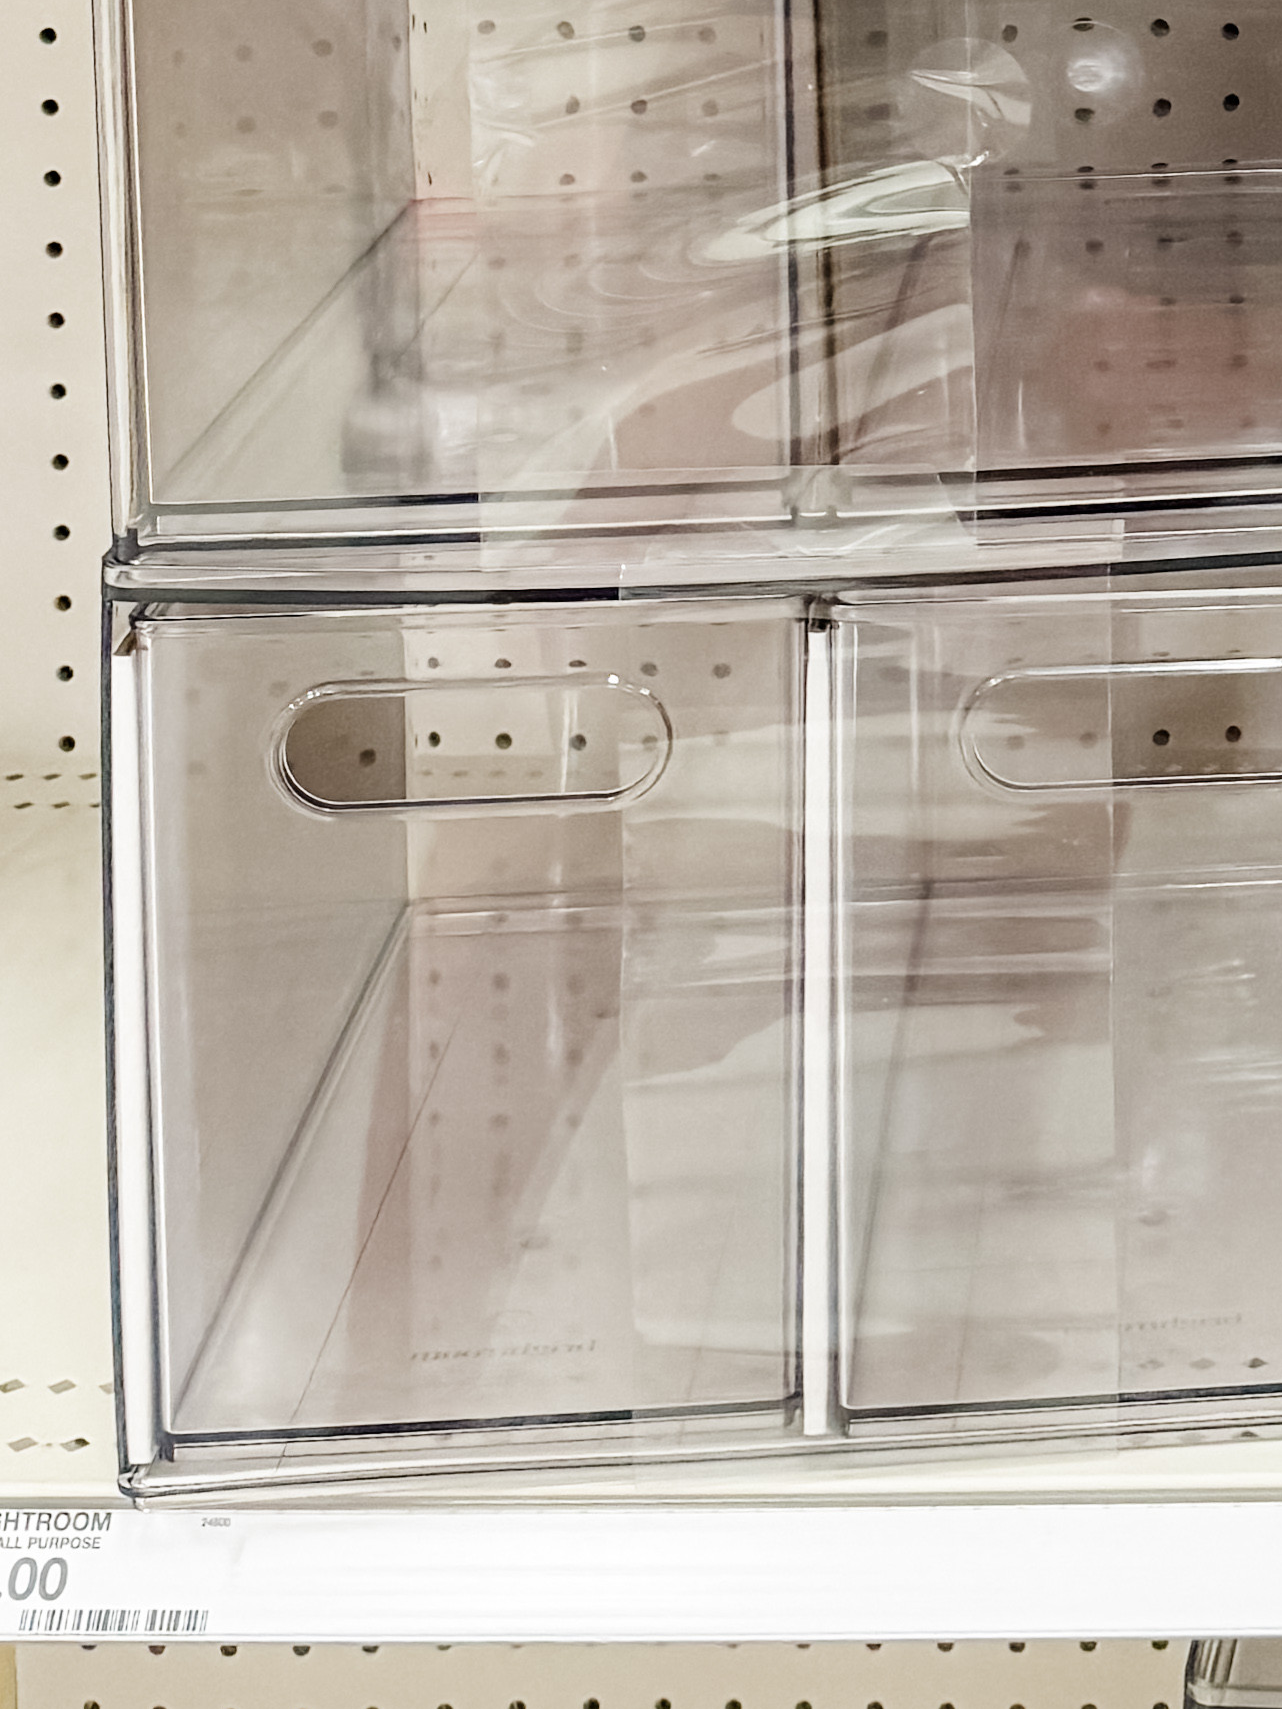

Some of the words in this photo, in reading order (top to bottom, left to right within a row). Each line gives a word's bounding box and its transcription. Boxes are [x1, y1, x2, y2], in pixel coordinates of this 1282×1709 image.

[0, 1511, 112, 1531] HTROOM
[27, 1536, 102, 1550] PURPOSE
[0, 1556, 68, 1601] 00
